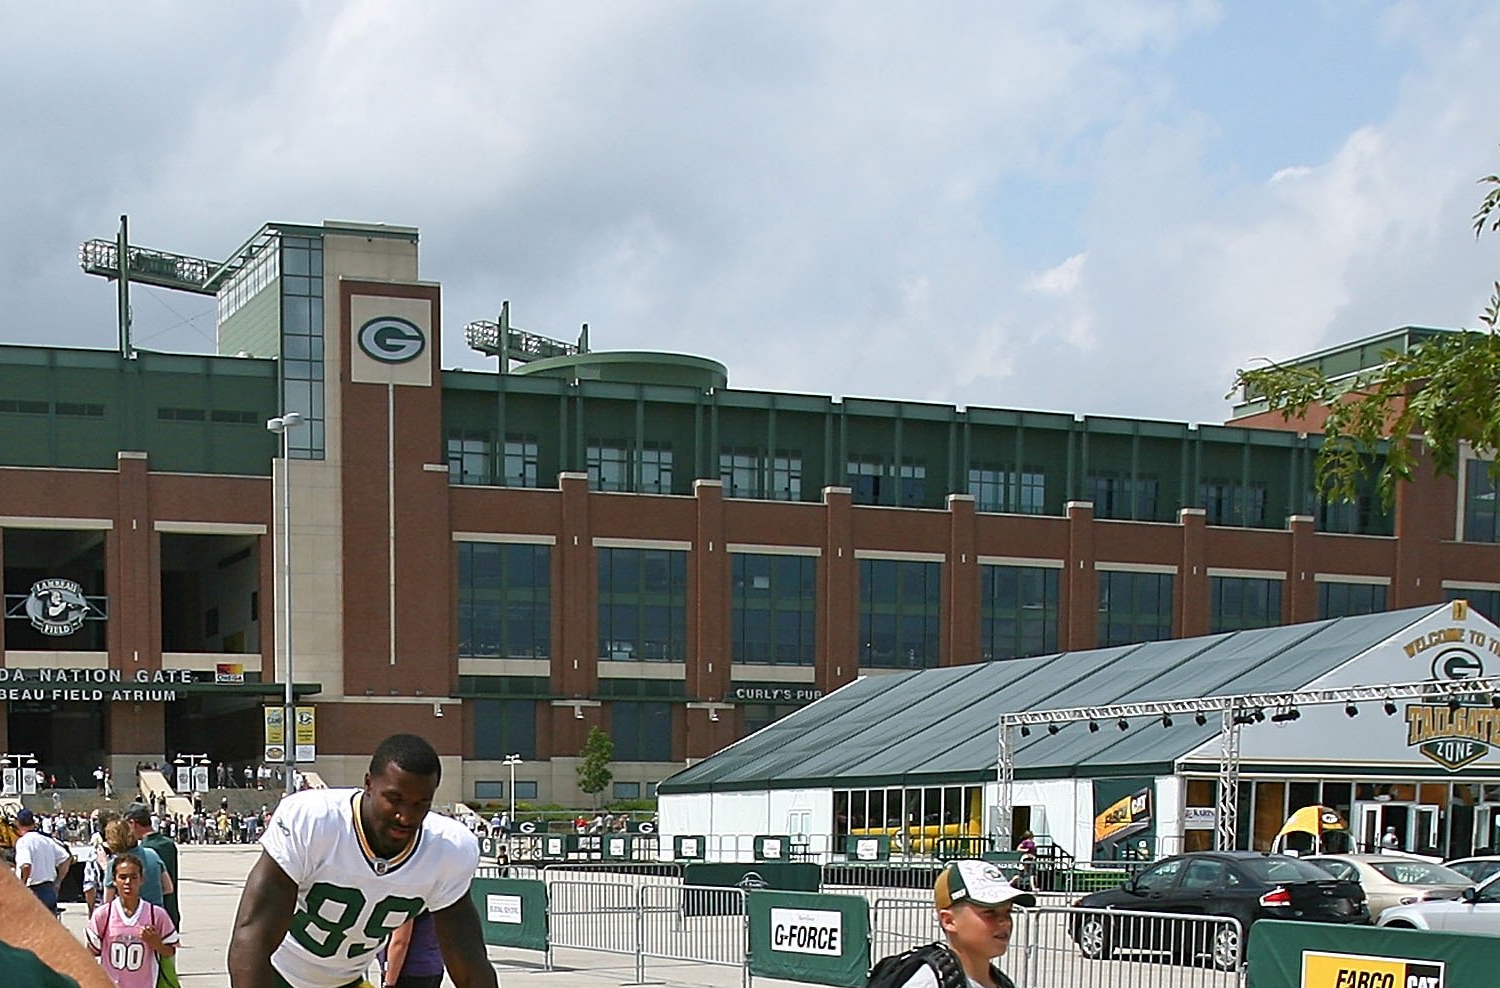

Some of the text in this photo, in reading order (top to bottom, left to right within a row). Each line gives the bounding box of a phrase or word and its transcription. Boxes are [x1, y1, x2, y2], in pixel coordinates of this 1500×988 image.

[1469, 629, 1486, 648] TO
[40, 669, 121, 682] NATION
[136, 670, 192, 684] GATE
[52, 689, 103, 700] FIELD
[112, 690, 176, 701] ATRIUM
[736, 688, 792, 700] CURLY'S
[1436, 741, 1474, 762] ZONE
[289, 882, 425, 959] 89
[774, 923, 839, 950] G-FORCE
[109, 942, 145, 972] 00
